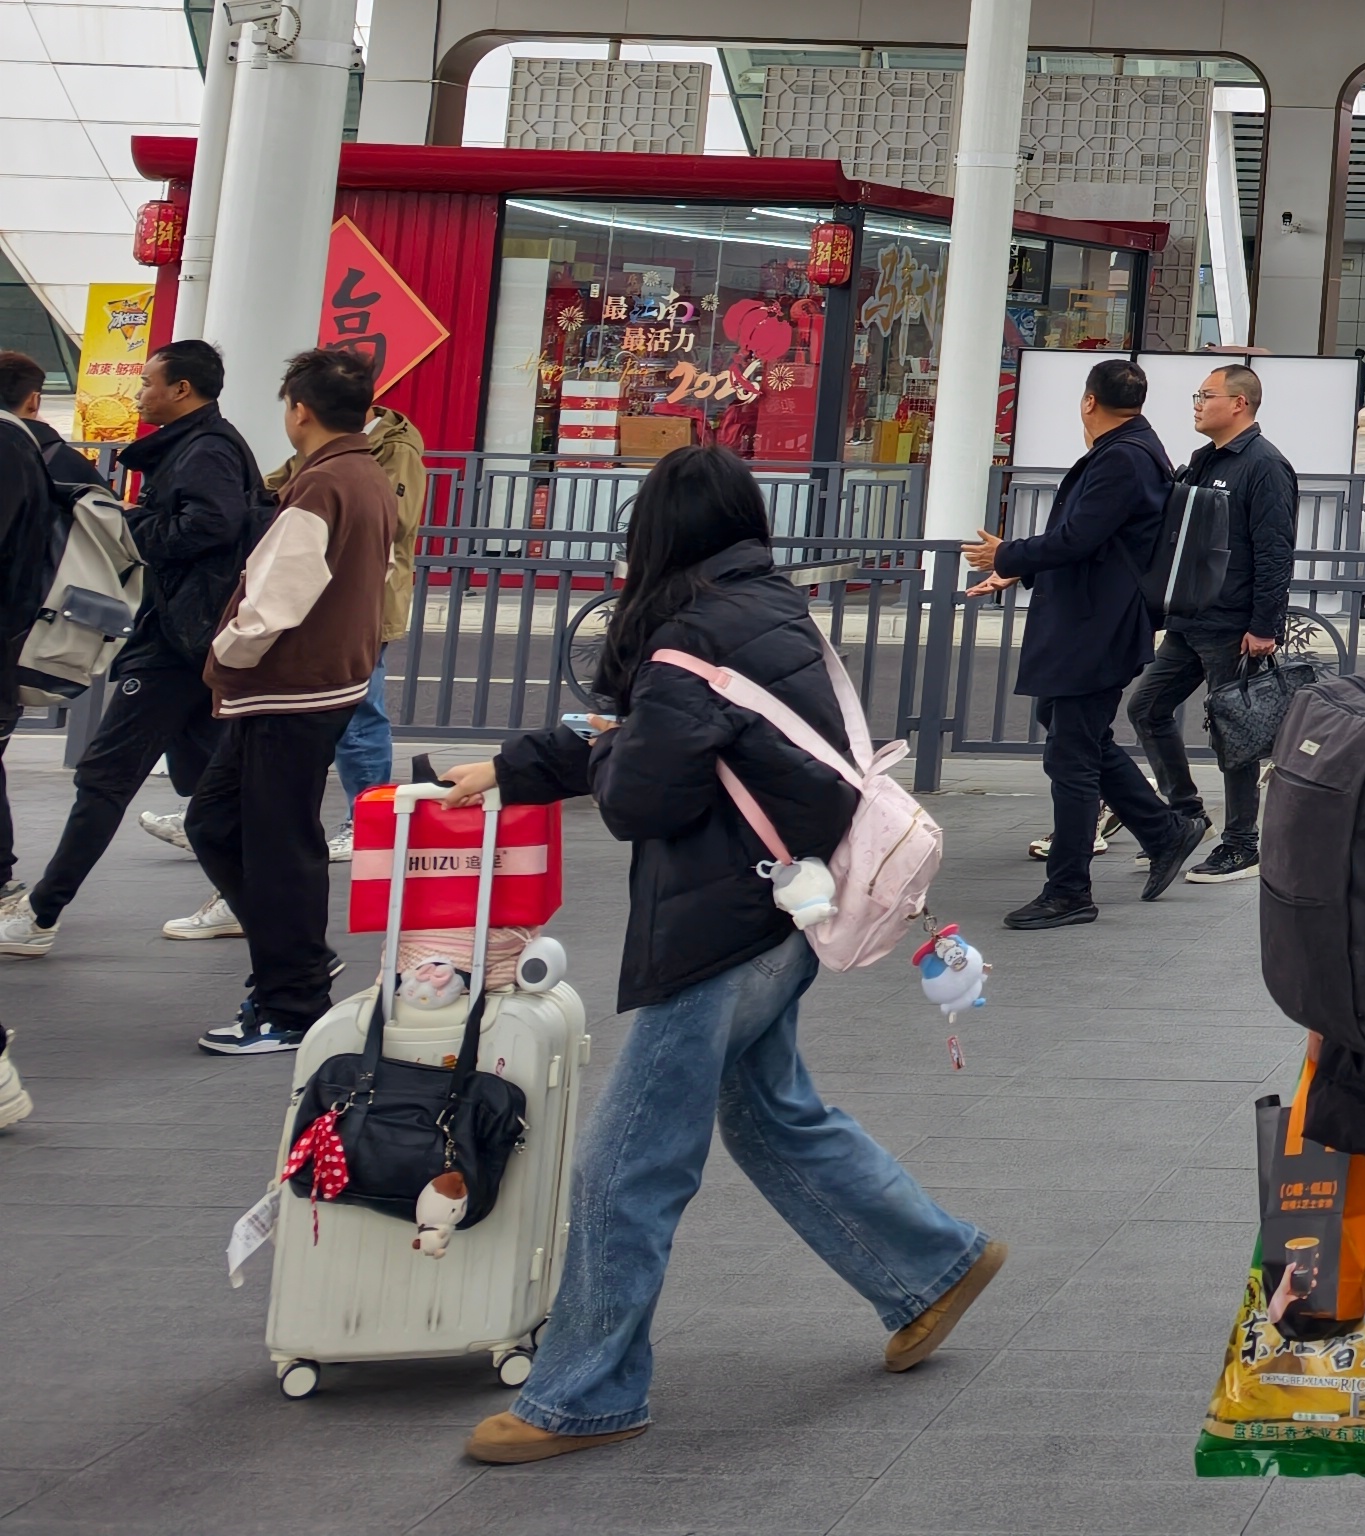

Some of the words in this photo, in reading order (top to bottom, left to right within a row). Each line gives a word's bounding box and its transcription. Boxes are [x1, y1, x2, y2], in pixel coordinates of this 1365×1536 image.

[621, 327, 695, 353] 最活力
[666, 358, 763, 407] 2026
[1213, 479, 1227, 488] FILA
[408, 856, 460, 871] HUIZU
